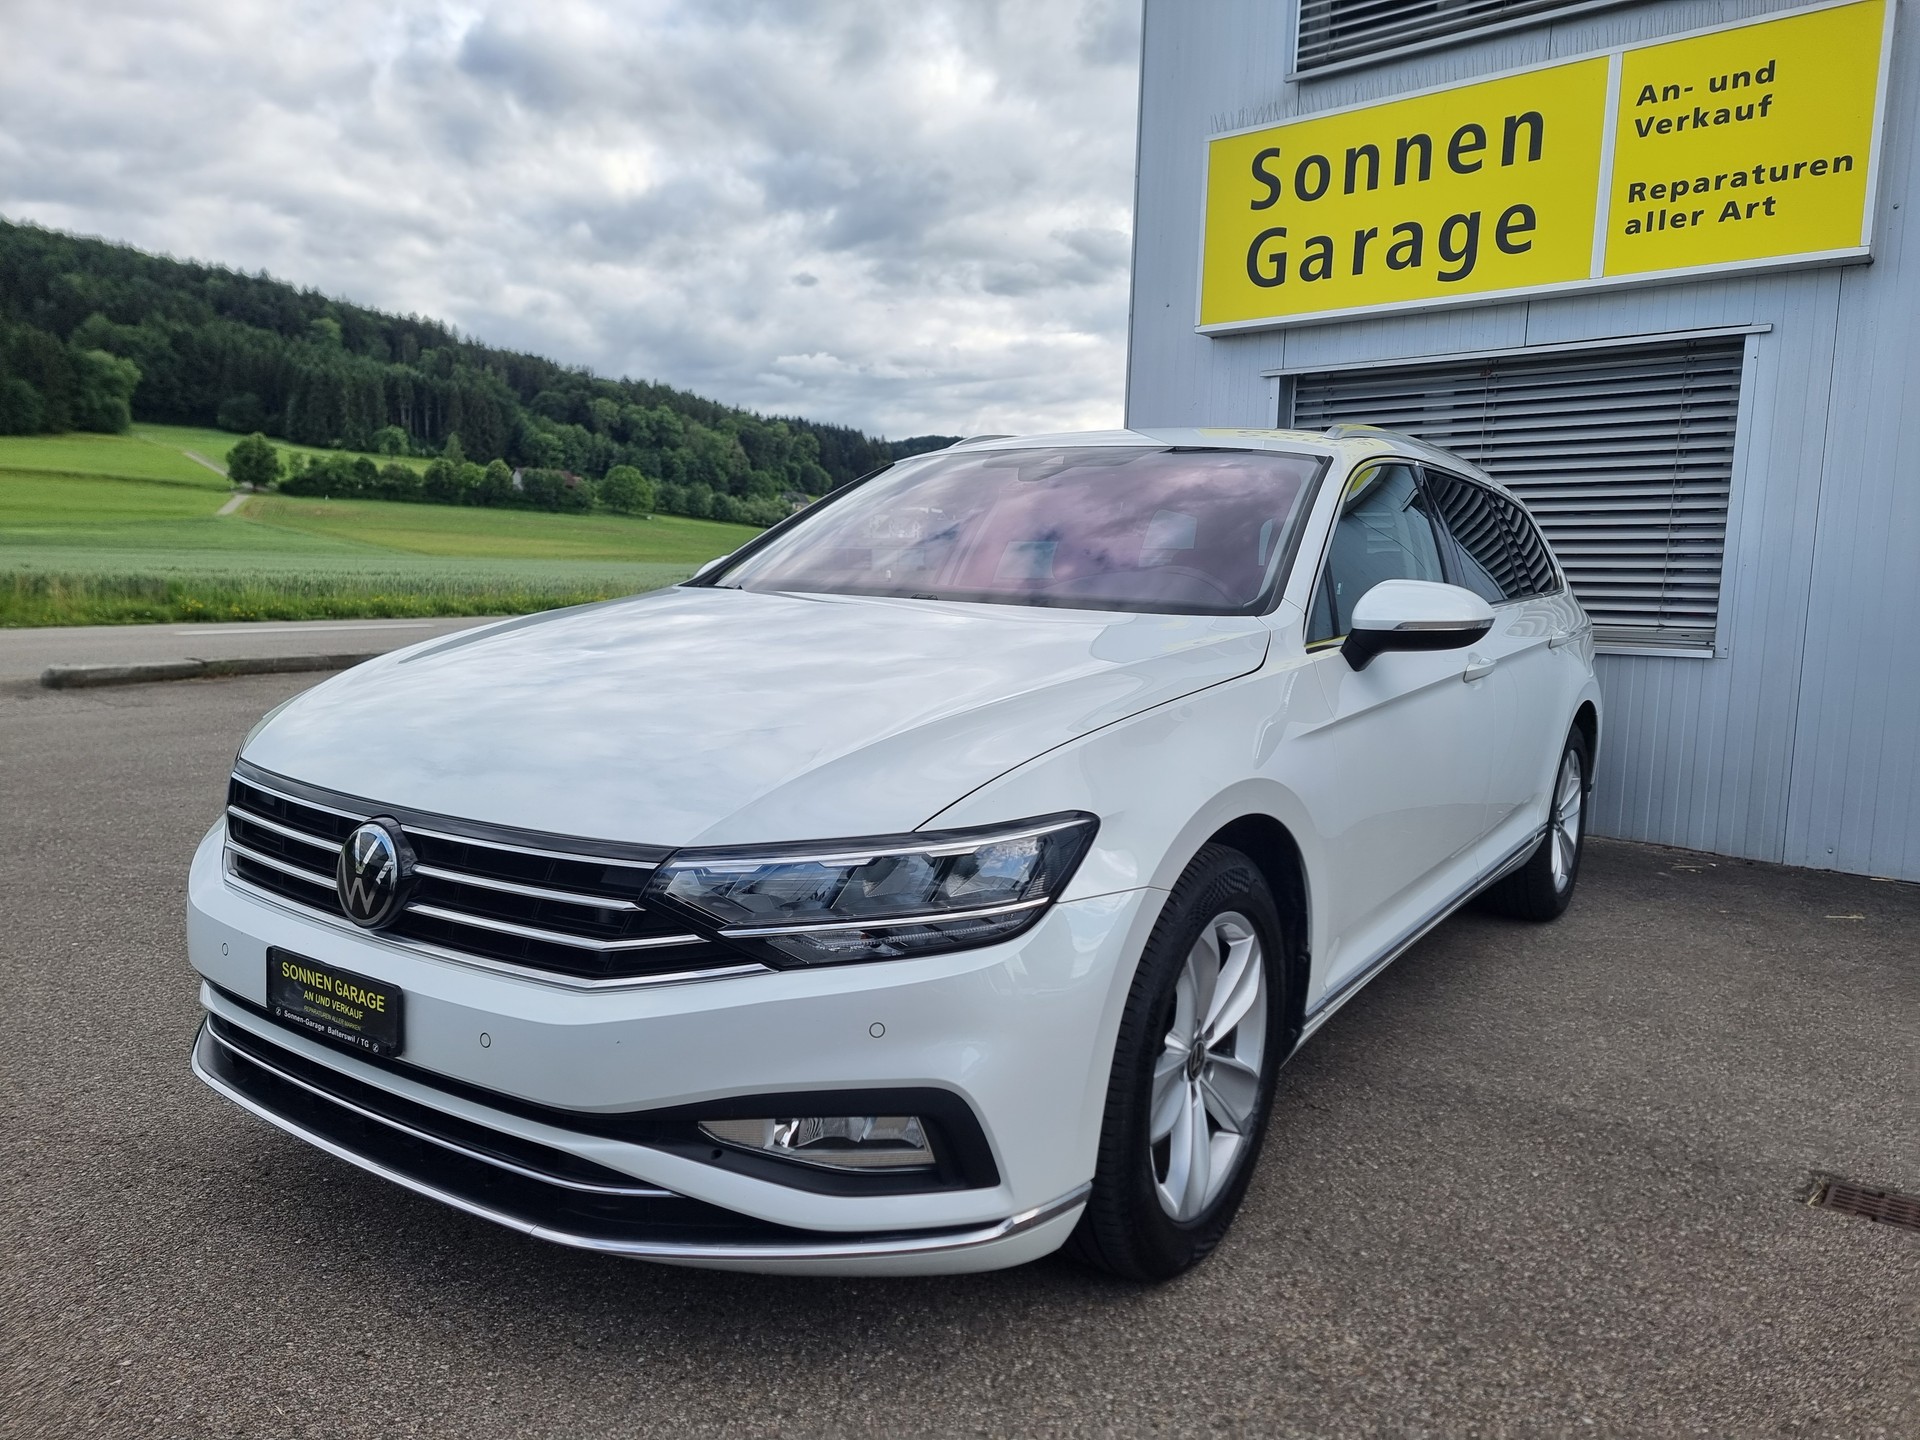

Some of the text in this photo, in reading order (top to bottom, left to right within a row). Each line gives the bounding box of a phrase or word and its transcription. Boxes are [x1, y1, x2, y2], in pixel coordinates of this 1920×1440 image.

[1635, 59, 1776, 107] An- und
[1634, 93, 1774, 138] Verkauf
[1249, 110, 1545, 212] Sonnen
[1628, 154, 1854, 204] Reparaturen
[1624, 195, 1776, 236] aller Art
[1246, 203, 1538, 288] Garage
[282, 962, 385, 1012] SONNEN GARAGE
[303, 990, 364, 1020] AN UND VERKAUF
[284, 1010, 325, 1031] Sonnen-Garage
[327, 1026, 356, 1043] Balterswil
[360, 1038, 370, 1048] TG
